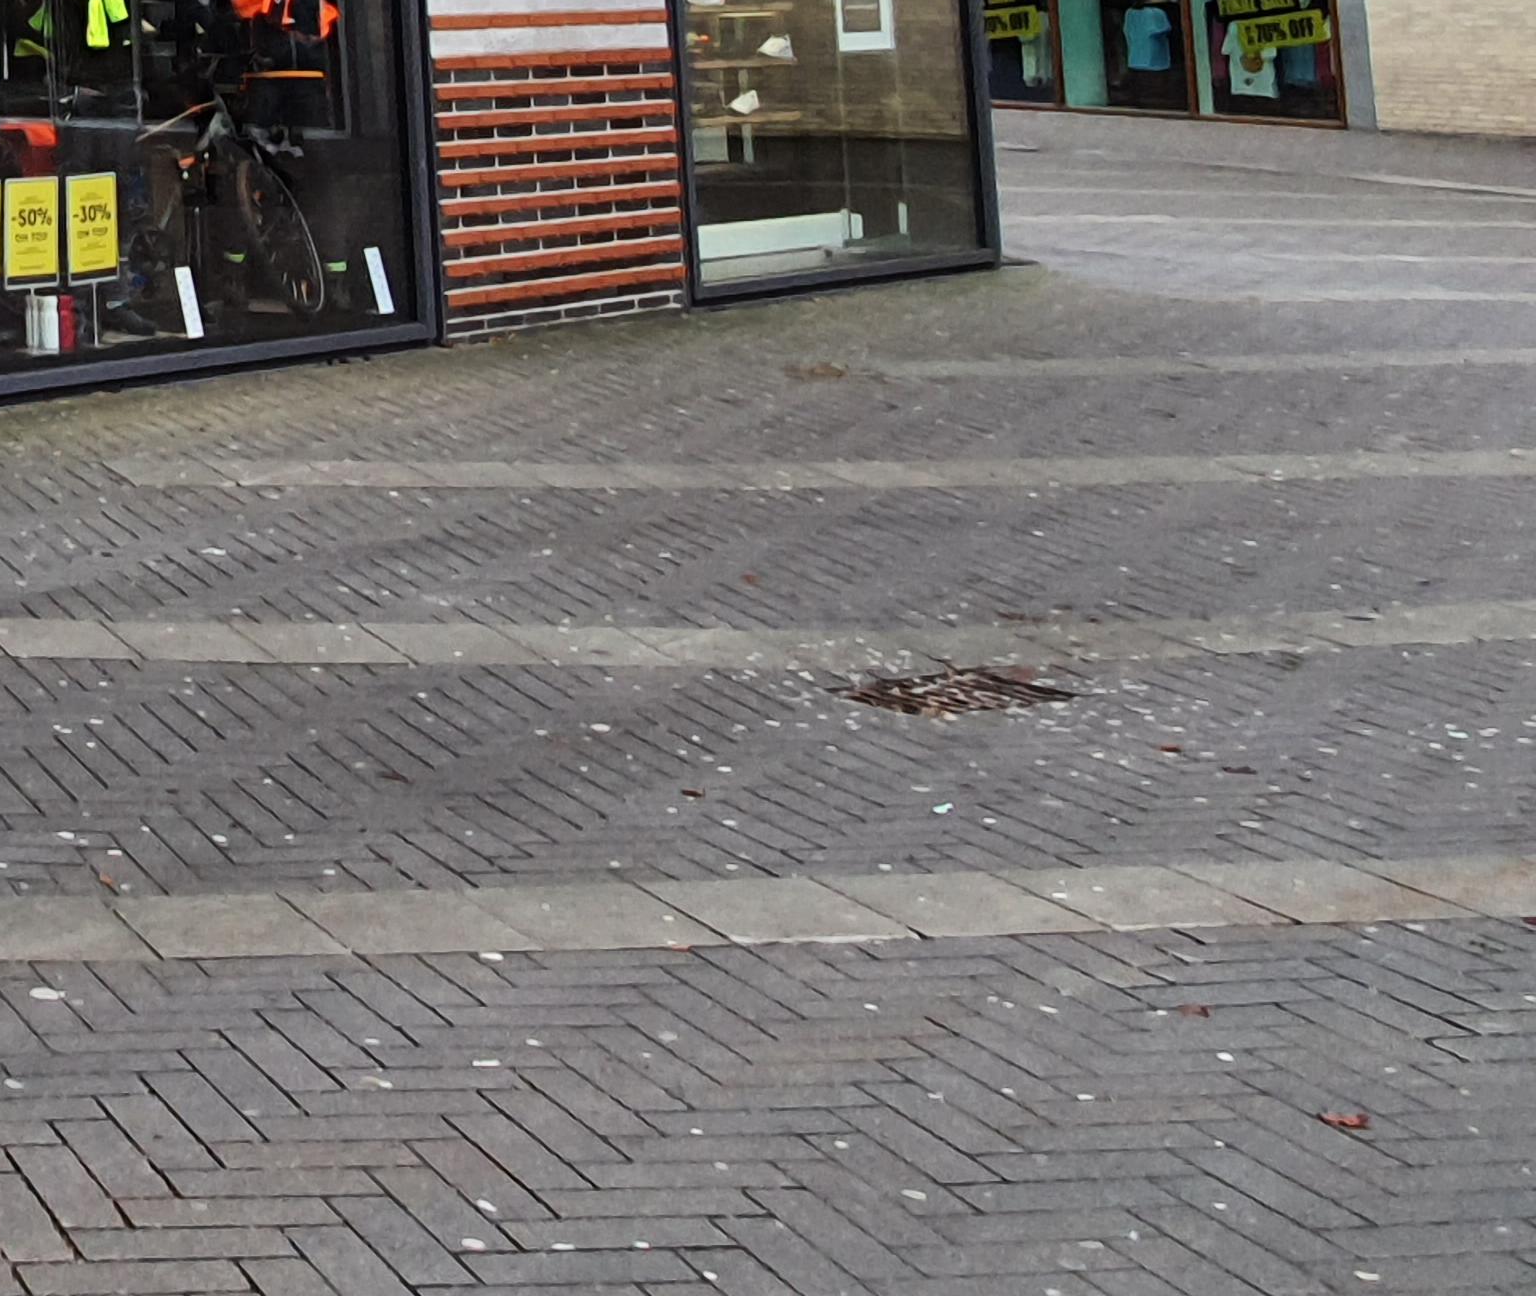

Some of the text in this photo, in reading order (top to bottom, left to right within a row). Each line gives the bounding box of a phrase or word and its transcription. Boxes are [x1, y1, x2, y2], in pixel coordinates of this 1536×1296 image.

[1289, 16, 1315, 39] OFF
[11, 207, 53, 227] -50%
[73, 202, 111, 223] -30%
